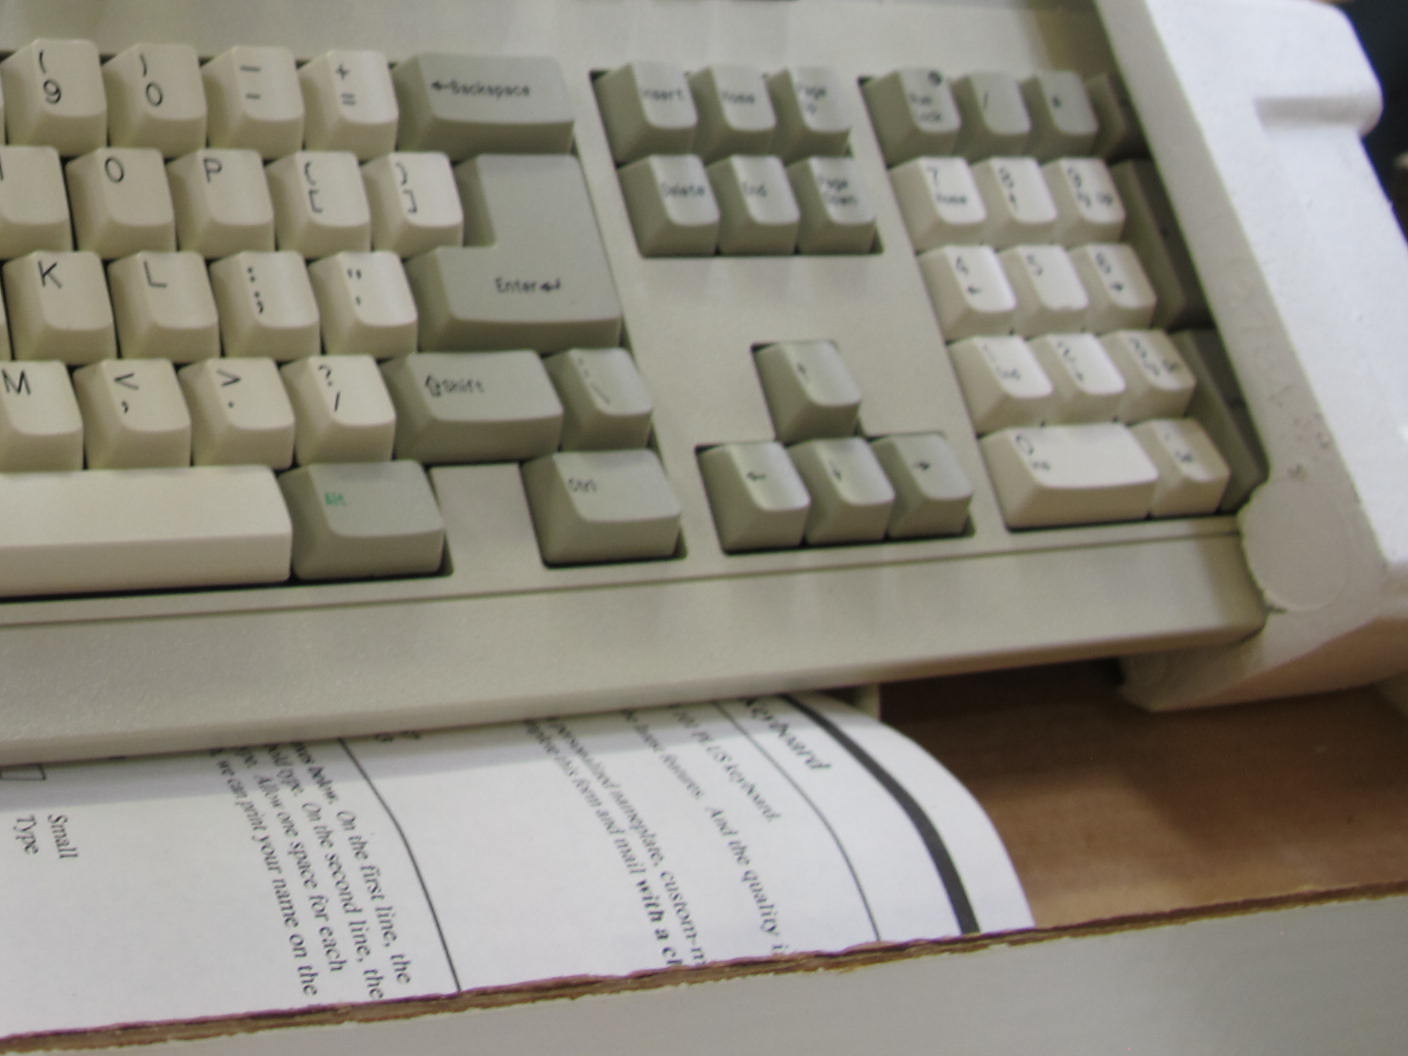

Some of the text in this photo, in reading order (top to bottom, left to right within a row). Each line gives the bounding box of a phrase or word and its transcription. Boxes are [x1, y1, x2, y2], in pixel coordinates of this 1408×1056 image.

[43, 79, 62, 104] 9
[104, 156, 125, 184] O
[203, 157, 222, 183] P
[38, 260, 62, 289] K
[144, 261, 168, 288] L
[495, 277, 538, 293] Enter
[2, 369, 31, 395] M
[234, 801, 267, 831] print
[276, 811, 300, 837] one
[13, 814, 39, 855] Type
[47, 814, 79, 859] Small
[251, 833, 282, 875] your
[288, 840, 318, 890] space
[595, 809, 626, 835] and
[613, 838, 646, 874] mail
[636, 879, 664, 922] with
[654, 928, 669, 940] a
[705, 806, 739, 836] And
[728, 840, 750, 866] the
[741, 870, 780, 936] quality
[272, 878, 299, 928] name
[309, 895, 330, 923] for
[313, 825, 335, 848] the
[324, 852, 364, 914] second
[348, 920, 371, 963] line,
[363, 969, 385, 1000] the
[336, 810, 357, 831] On
[348, 835, 369, 860] the
[360, 865, 386, 901] first
[375, 905, 398, 948] line,
[390, 954, 412, 985] the
[289, 933, 308, 958] on
[319, 926, 348, 972] each
[297, 965, 319, 996] the
